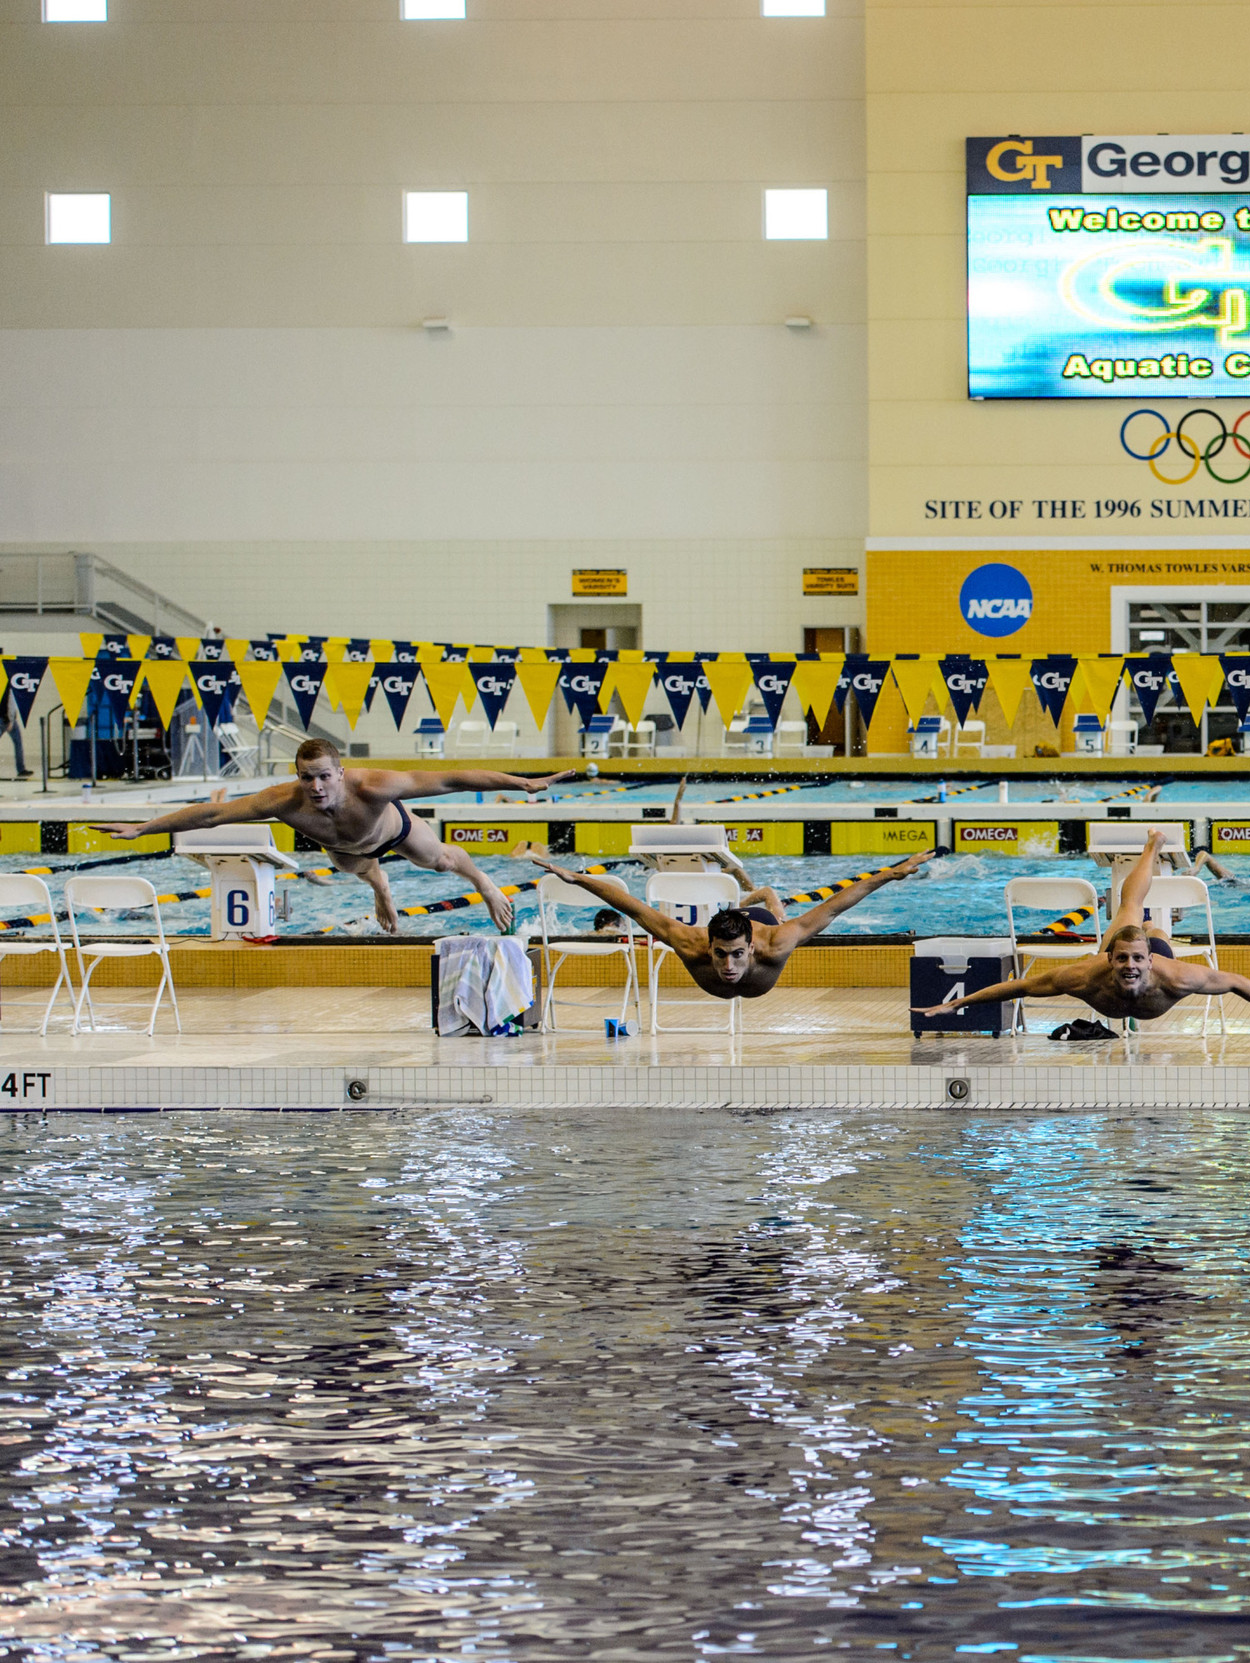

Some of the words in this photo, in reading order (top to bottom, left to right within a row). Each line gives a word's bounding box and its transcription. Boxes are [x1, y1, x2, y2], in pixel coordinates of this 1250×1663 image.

[986, 140, 1063, 189] GT
[1049, 208, 1225, 232] Welcome
[1062, 354, 1213, 382] Aquatic
[925, 500, 982, 519] SITE
[989, 500, 1023, 519] OF
[1032, 500, 1086, 519] THE
[1094, 500, 1142, 518] 1996
[1090, 563, 1104, 573] W.
[1108, 563, 1162, 573] THOMAS
[1165, 563, 1218, 573] TOWLES
[967, 598, 1031, 619] NCAA
[10, 673, 40, 692] GT
[104, 674, 133, 694] GT
[197, 675, 226, 694] GT
[291, 675, 320, 694] GT
[384, 676, 412, 695] GT
[477, 676, 506, 695] GT
[571, 676, 600, 694] GT
[664, 675, 694, 695] GT
[758, 675, 787, 694] GT
[853, 674, 882, 693] GT
[947, 674, 976, 693] GT
[1041, 672, 1070, 691] GT
[1134, 671, 1163, 690] GT
[1085, 739, 1094, 753] 5
[963, 829, 1015, 840] OMEGA
[227, 890, 249, 926] 6
[1, 1073, 18, 1098] 4
[23, 1073, 51, 1098] FT
